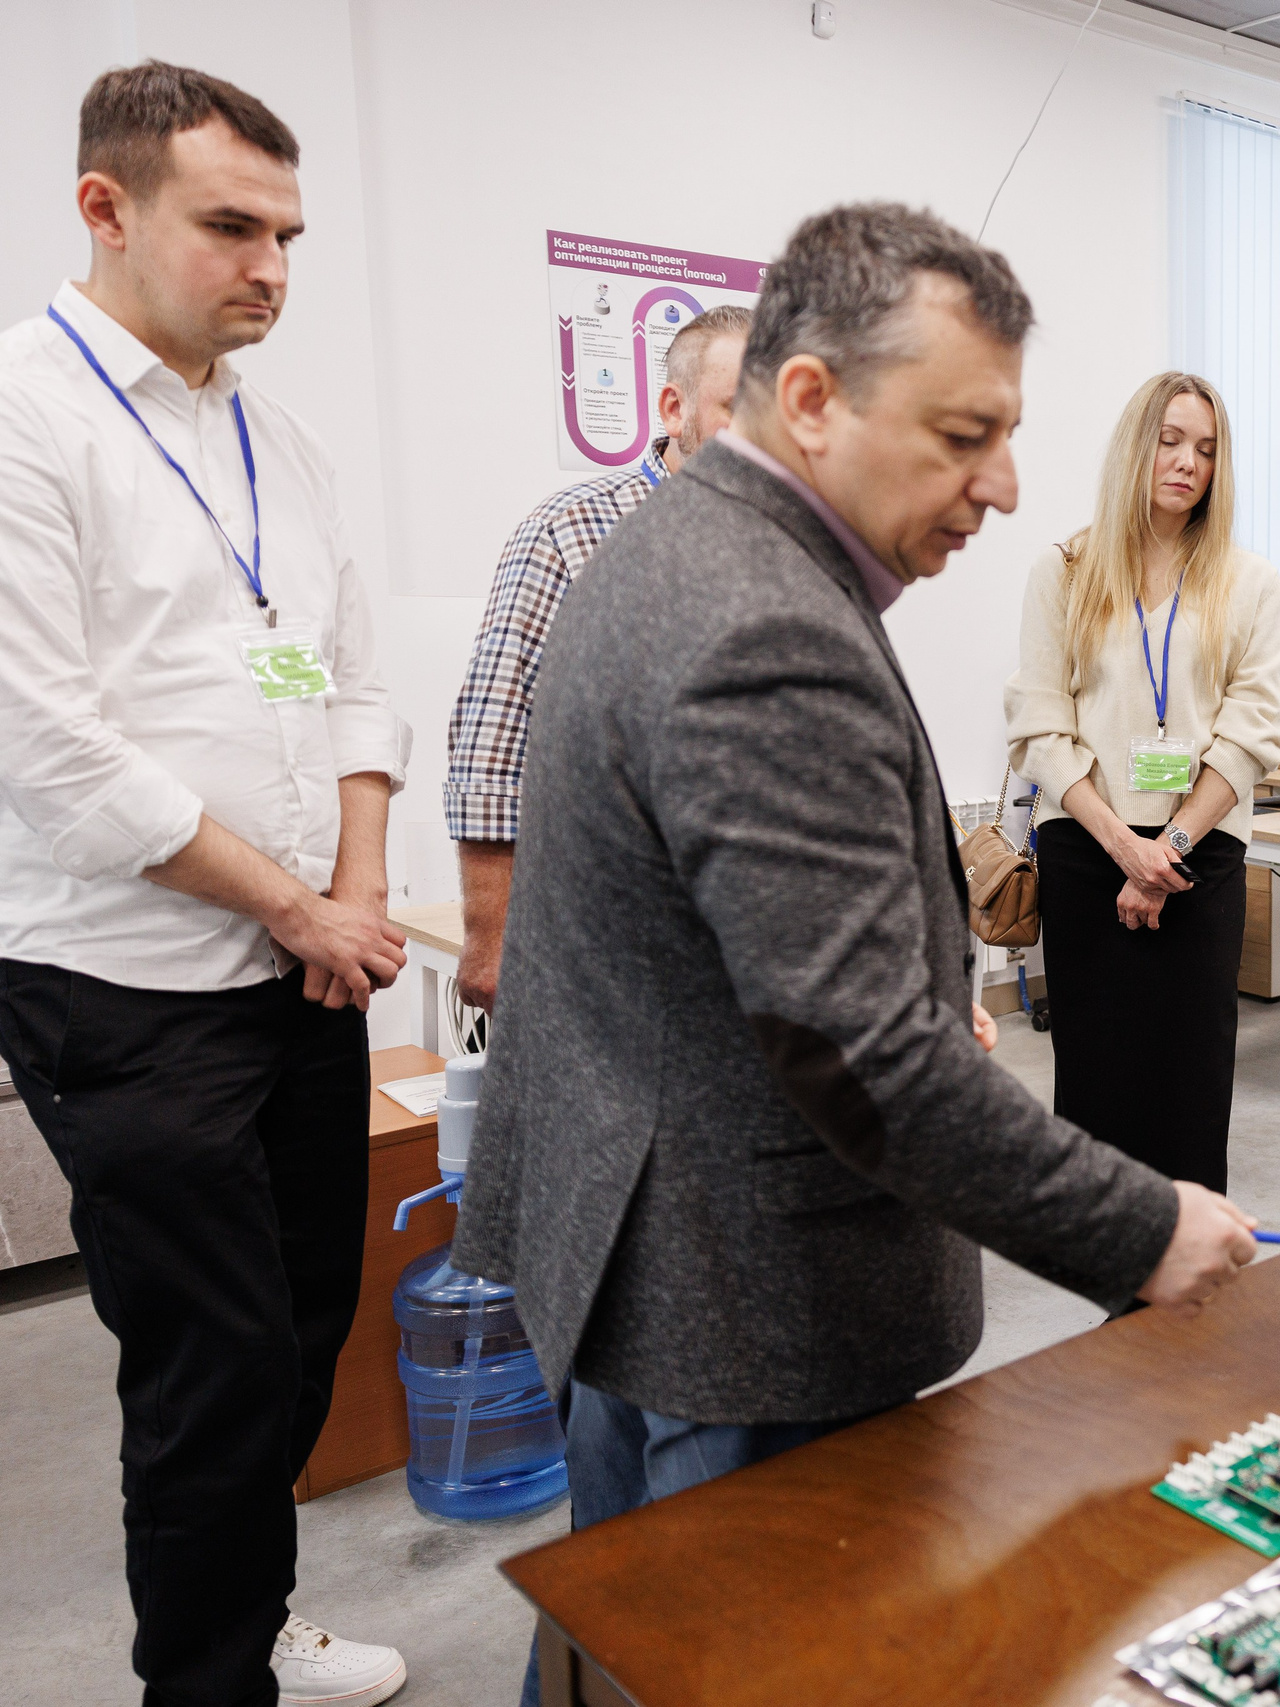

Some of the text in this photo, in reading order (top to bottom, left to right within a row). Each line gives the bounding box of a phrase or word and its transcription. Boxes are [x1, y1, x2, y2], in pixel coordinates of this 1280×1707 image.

[553, 237, 688, 267] Как реализовать проект
[554, 250, 727, 284] оптимизации процесса (потока)
[669, 305, 675, 313] 2
[602, 368, 608, 377] 1
